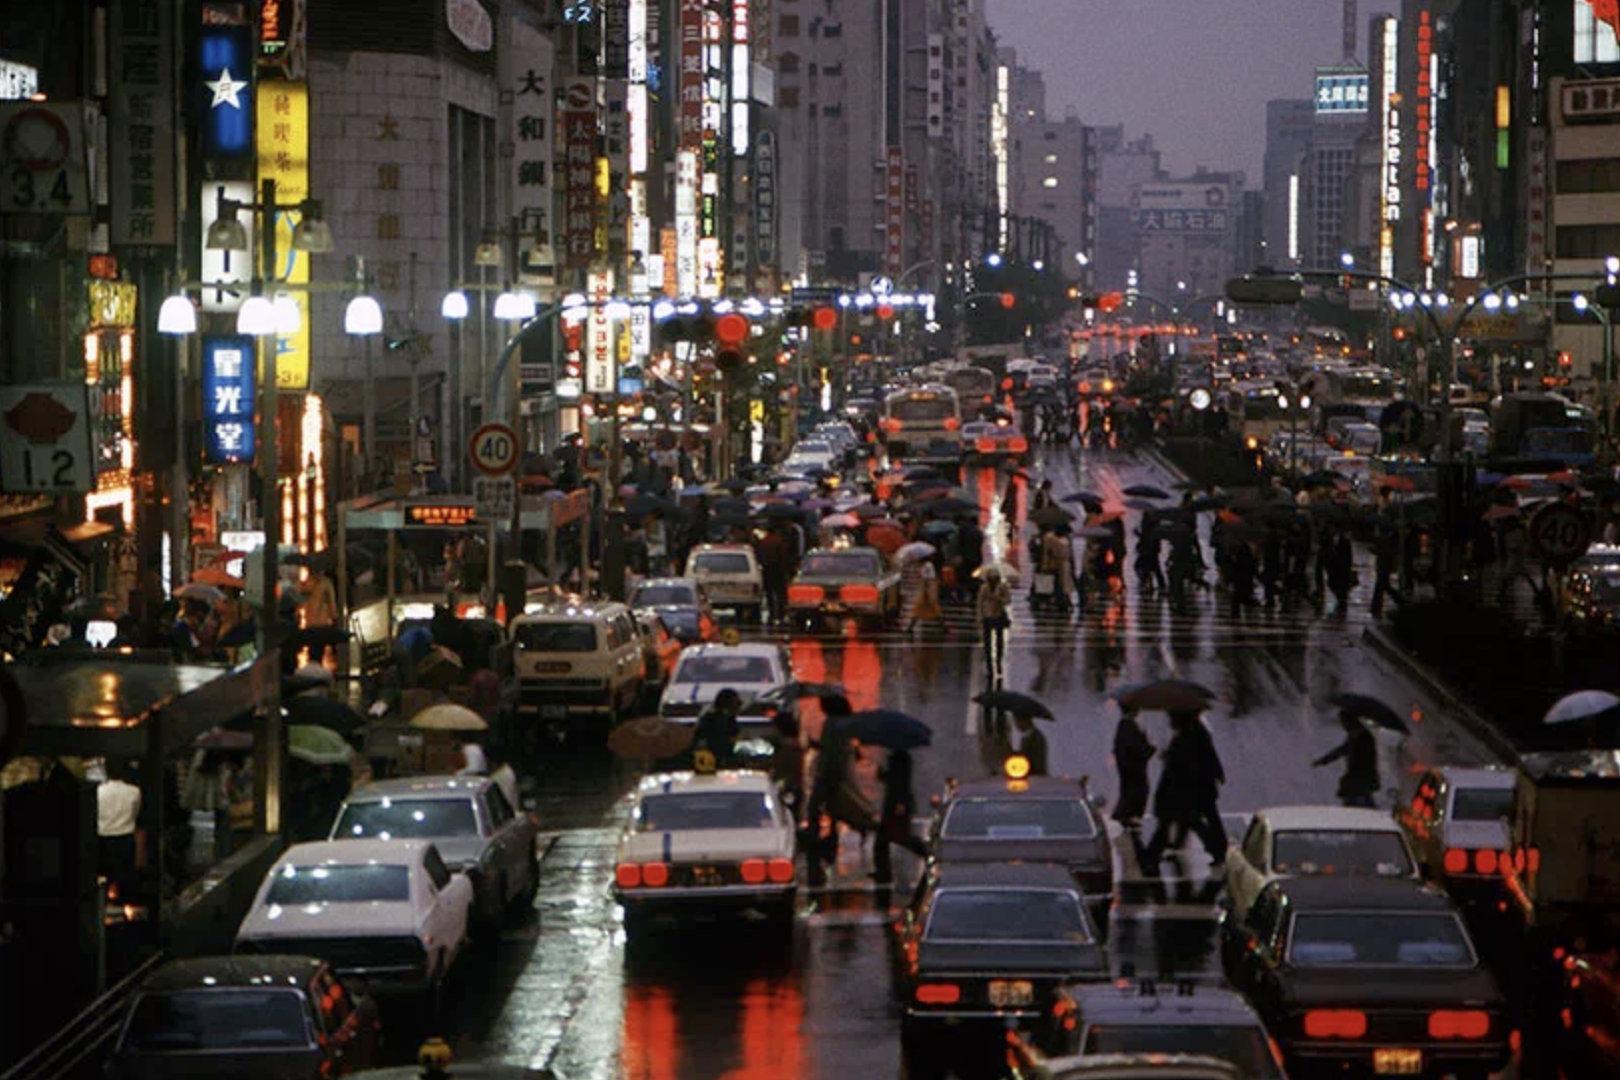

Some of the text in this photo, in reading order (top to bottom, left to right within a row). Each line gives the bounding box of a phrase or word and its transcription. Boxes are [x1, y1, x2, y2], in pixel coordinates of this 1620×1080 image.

[517, 69, 546, 236] 大和銀行
[12, 169, 72, 207] 3.4
[481, 438, 506, 460] 40
[23, 450, 75, 488] 1.2
[1542, 516, 1578, 545] 40
